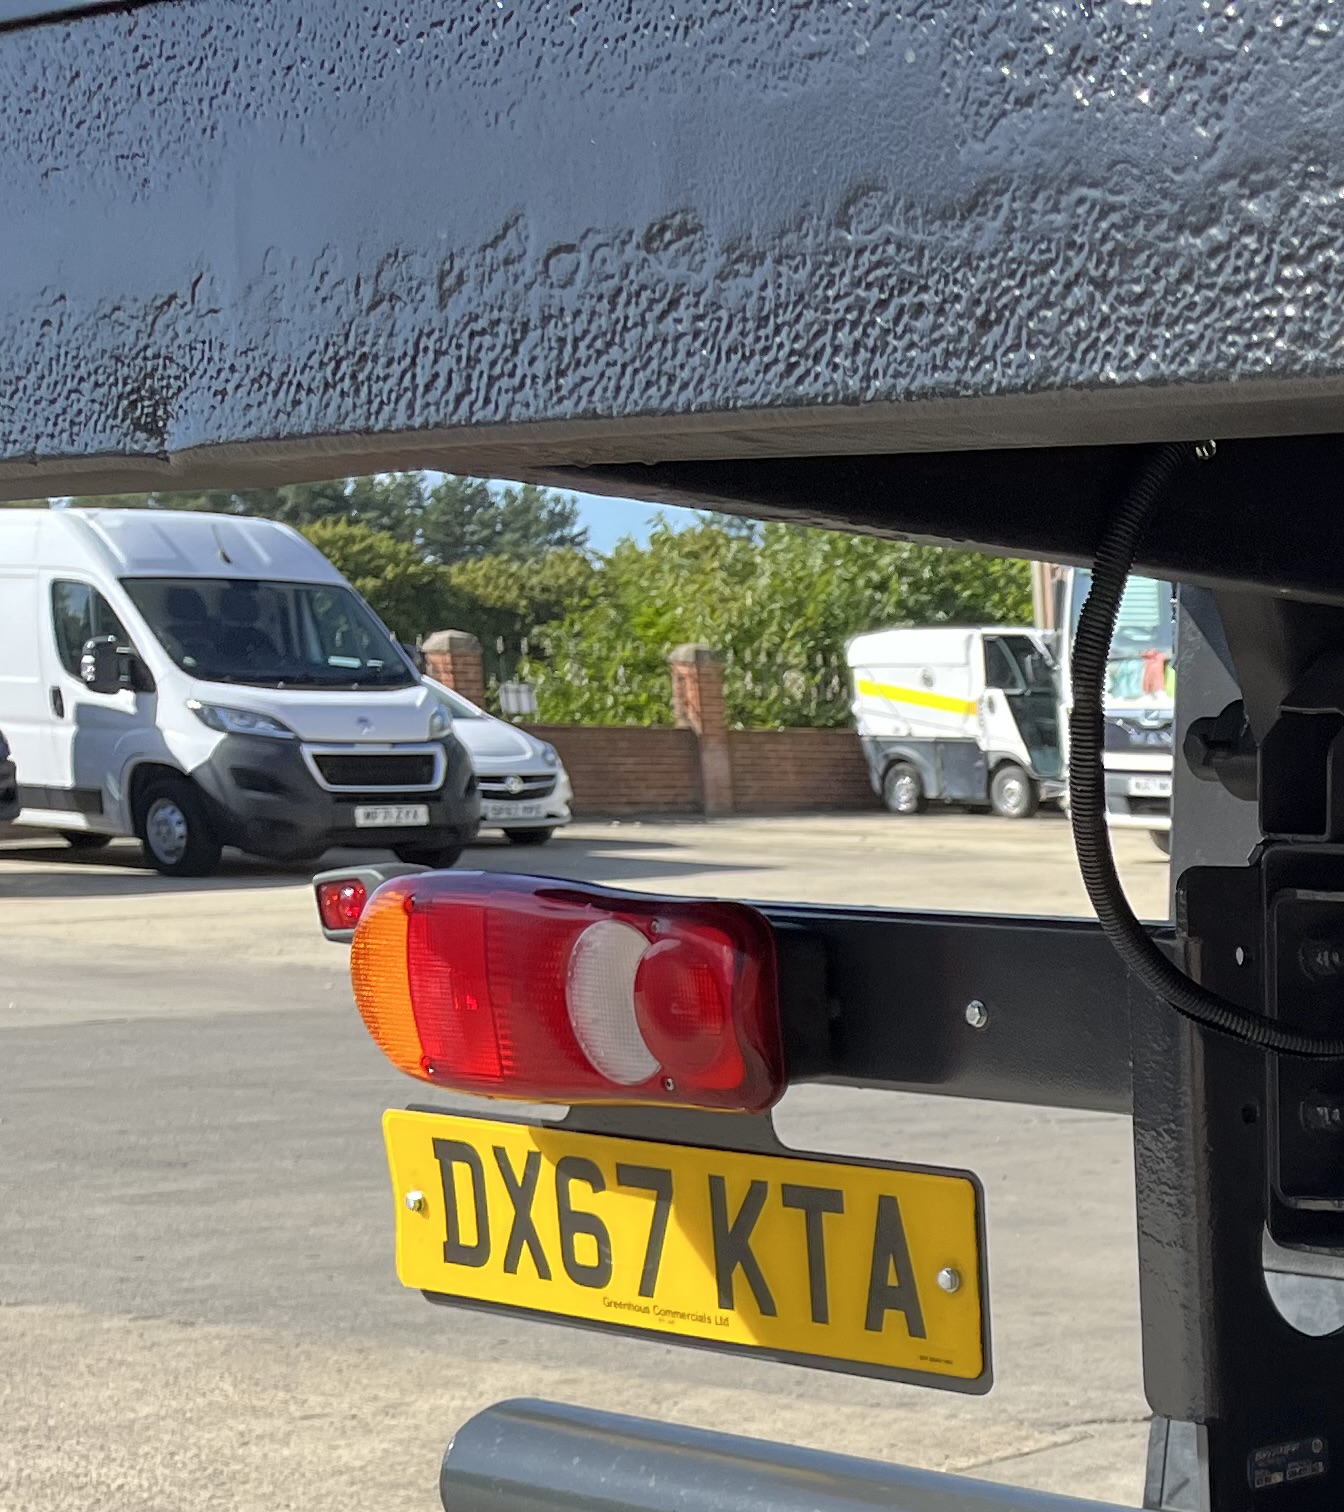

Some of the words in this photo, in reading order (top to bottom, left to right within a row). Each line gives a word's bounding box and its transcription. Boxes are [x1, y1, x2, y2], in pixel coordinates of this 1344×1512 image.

[432, 1136, 674, 1299] DX67
[708, 1173, 927, 1340] KTA
[653, 1304, 712, 1324] Commercials
[715, 1315, 730, 1327] Ltd
